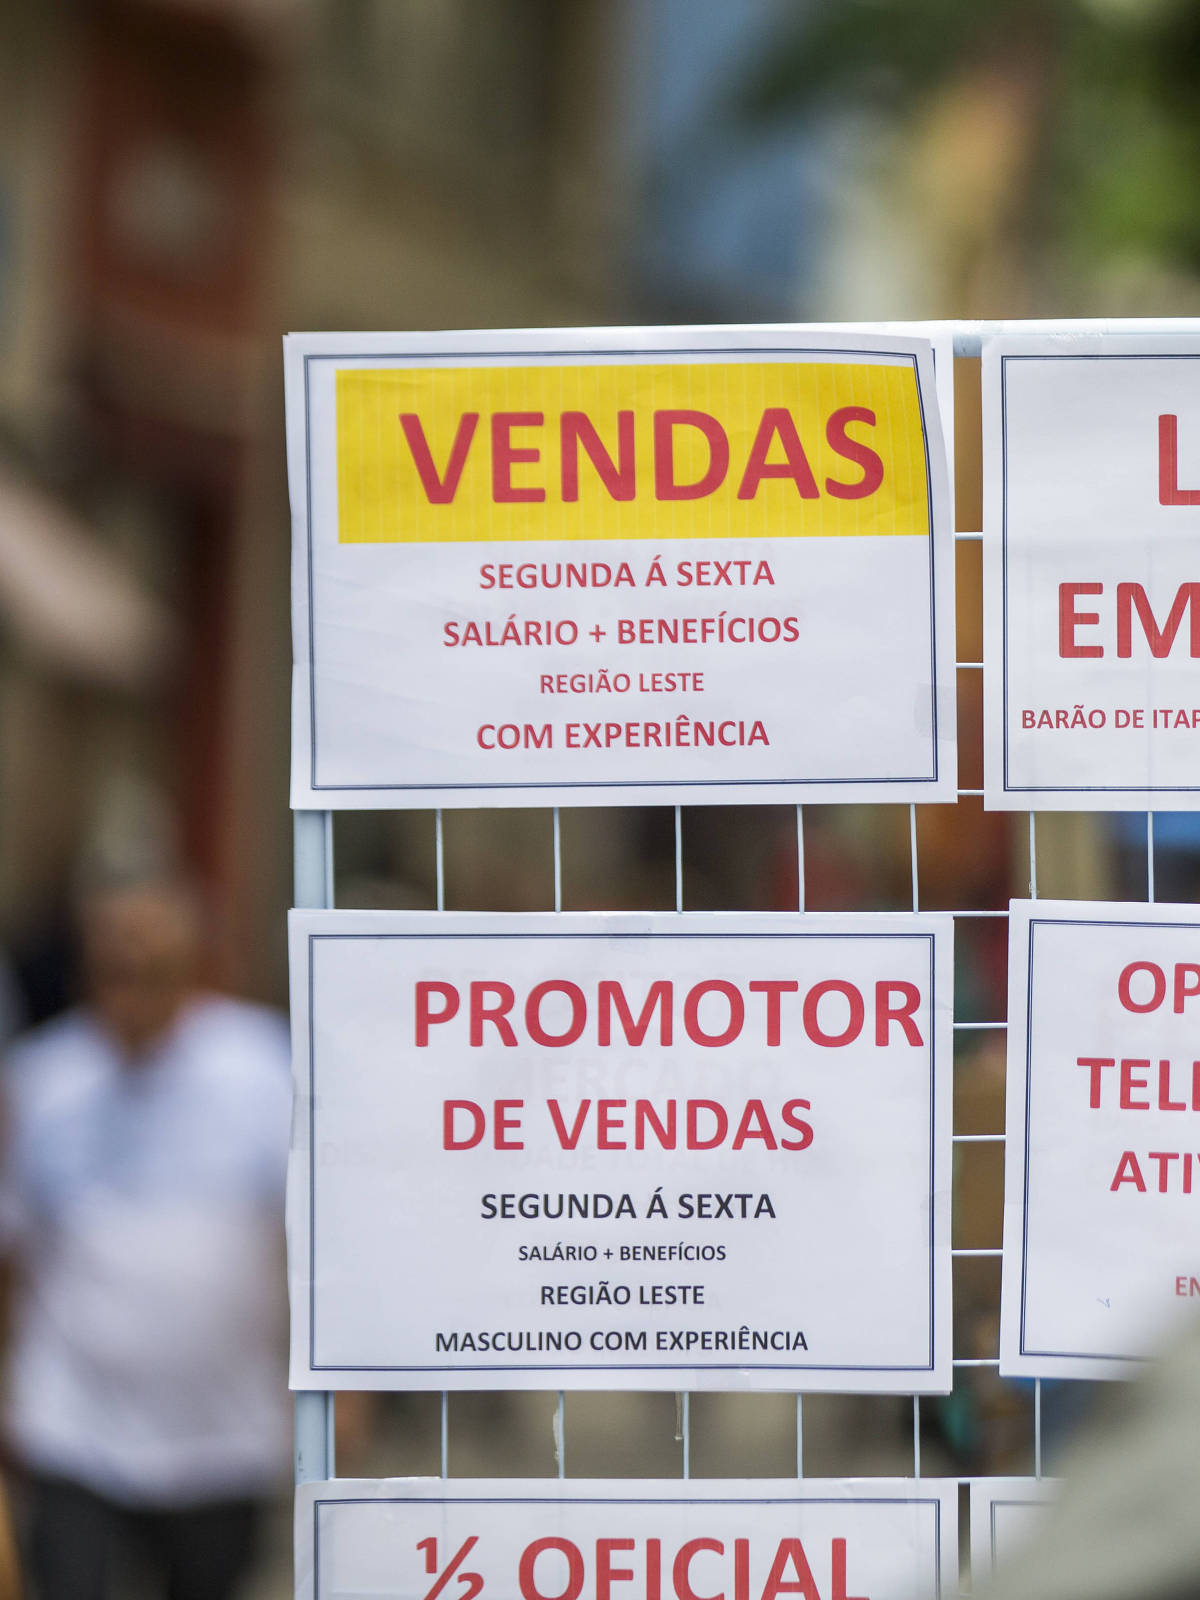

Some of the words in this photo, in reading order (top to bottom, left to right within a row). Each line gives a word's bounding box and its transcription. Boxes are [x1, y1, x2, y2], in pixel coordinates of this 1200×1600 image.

[399, 406, 885, 504] VENDAS
[479, 562, 637, 590] SEGUNDA
[644, 555, 668, 588] Á
[676, 560, 775, 587] SEXTA
[444, 613, 579, 648] SALÁRIO
[589, 624, 607, 644] +
[617, 611, 800, 645] BENEFÍCIOS
[540, 669, 631, 694] REGIÃO
[639, 672, 705, 693] LESTE
[477, 723, 553, 750] COM
[565, 714, 770, 749] EXPERIÊNCIA
[1021, 704, 1107, 729] BARÃO
[1114, 709, 1145, 729] DE
[415, 979, 925, 1048] PROMOTOR
[442, 1098, 525, 1151] DE
[546, 1098, 814, 1152] VENDAS
[480, 1193, 638, 1220] SEGUNDA
[645, 1187, 669, 1219] Á
[678, 1193, 776, 1219] SEXTA
[518, 1242, 597, 1262] SALÁRIO
[603, 1248, 614, 1260] +
[620, 1241, 727, 1262] BENEFÍCIOS
[541, 1280, 631, 1306] REGIÃO
[639, 1285, 705, 1305] LESTE
[434, 1331, 583, 1352] MASCULINO
[589, 1330, 648, 1351] COM
[655, 1325, 809, 1351] EXPERIÊNCIA
[518, 1536, 870, 1600] OFICIAL
